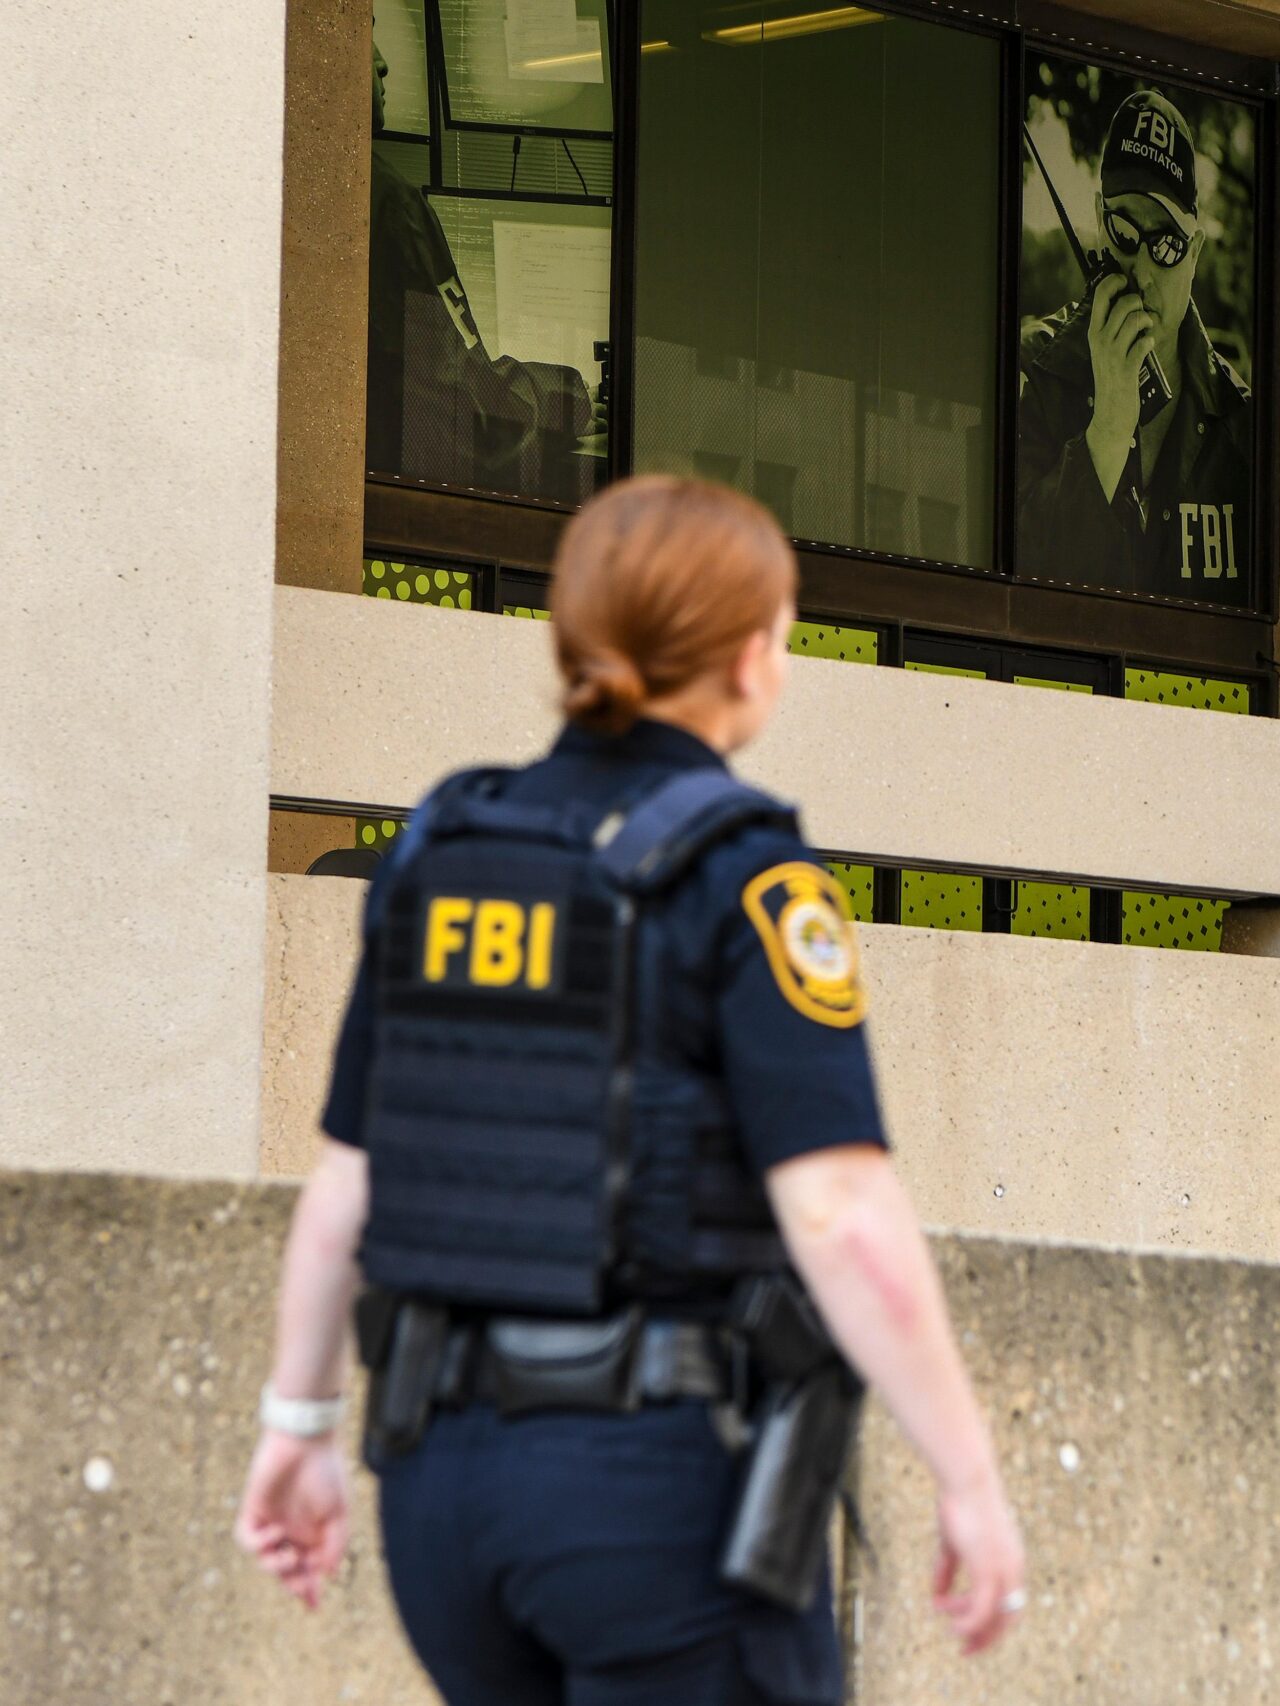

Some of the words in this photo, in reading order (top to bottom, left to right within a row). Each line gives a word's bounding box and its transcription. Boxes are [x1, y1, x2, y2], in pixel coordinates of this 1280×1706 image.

[1121, 138, 1183, 183] NEGOTIATOR
[1133, 111, 1175, 157] FBI
[1179, 503, 1238, 578] FBI
[423, 896, 556, 991] FBI
